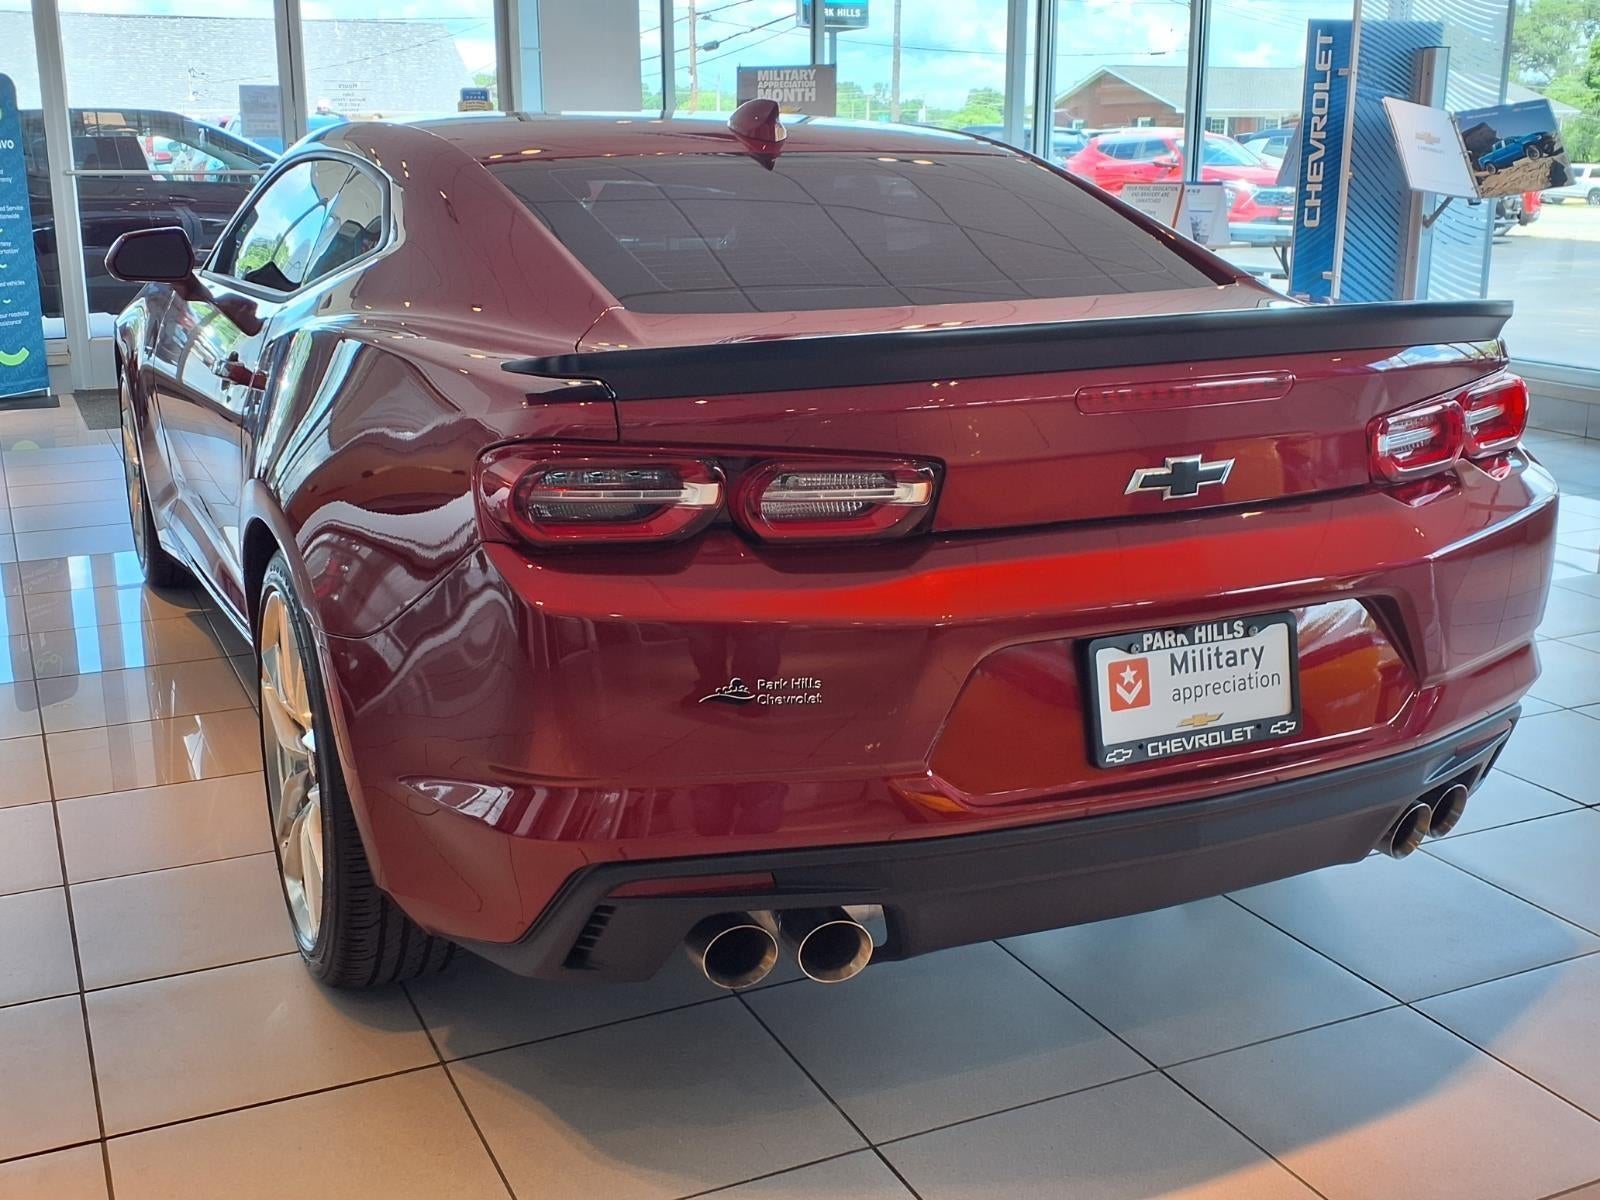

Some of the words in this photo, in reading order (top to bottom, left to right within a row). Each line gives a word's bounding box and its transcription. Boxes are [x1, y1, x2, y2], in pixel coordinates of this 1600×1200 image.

[837, 8, 861, 17] HILLS
[757, 69, 816, 81] MILITARY
[757, 80, 816, 89] APPRECIATION
[757, 88, 816, 102] MONTH
[1303, 29, 1333, 228] CHEVROLET
[1194, 620, 1244, 644] HILLS
[1169, 646, 1265, 676] Military
[757, 677, 788, 690] Park
[791, 677, 822, 689] Hills
[1172, 671, 1281, 704] appreciation
[757, 693, 822, 705] Chevrolet
[1147, 726, 1254, 757] CHEVROLET
